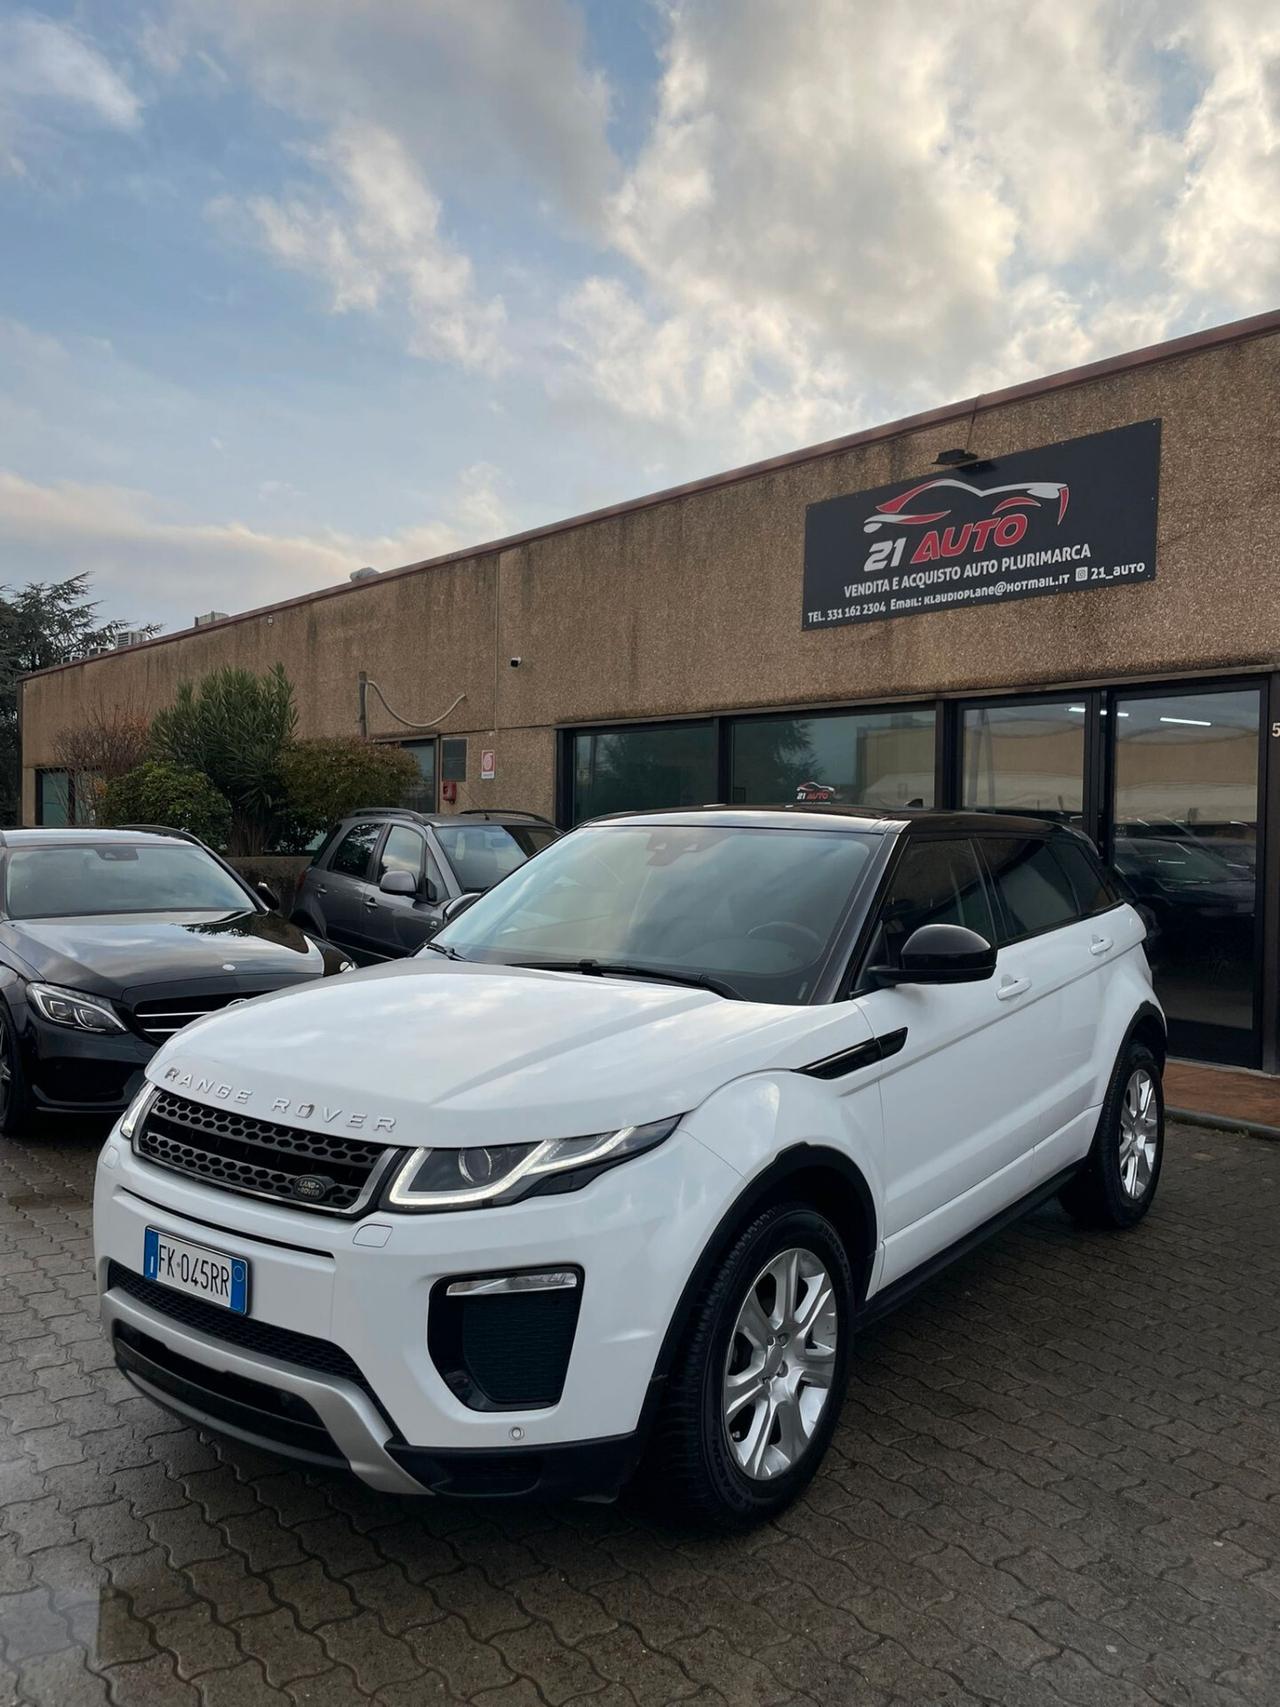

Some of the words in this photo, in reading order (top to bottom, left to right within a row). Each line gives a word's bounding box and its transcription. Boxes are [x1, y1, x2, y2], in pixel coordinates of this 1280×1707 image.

[844, 576, 890, 598] VENDITA
[892, 578, 899, 590] E
[901, 566, 961, 588] ACQUISTO
[963, 559, 998, 578] AUTO
[1002, 543, 1091, 572] PLURIMARCA
[863, 537, 907, 572] 21
[910, 513, 1029, 564] AUTO
[807, 611, 825, 623] TEL.
[827, 608, 843, 621] 331
[844, 605, 861, 617] 162
[862, 601, 886, 615] 2304
[164, 1067, 253, 1104] RANGE
[271, 1097, 397, 1132] ROVER
